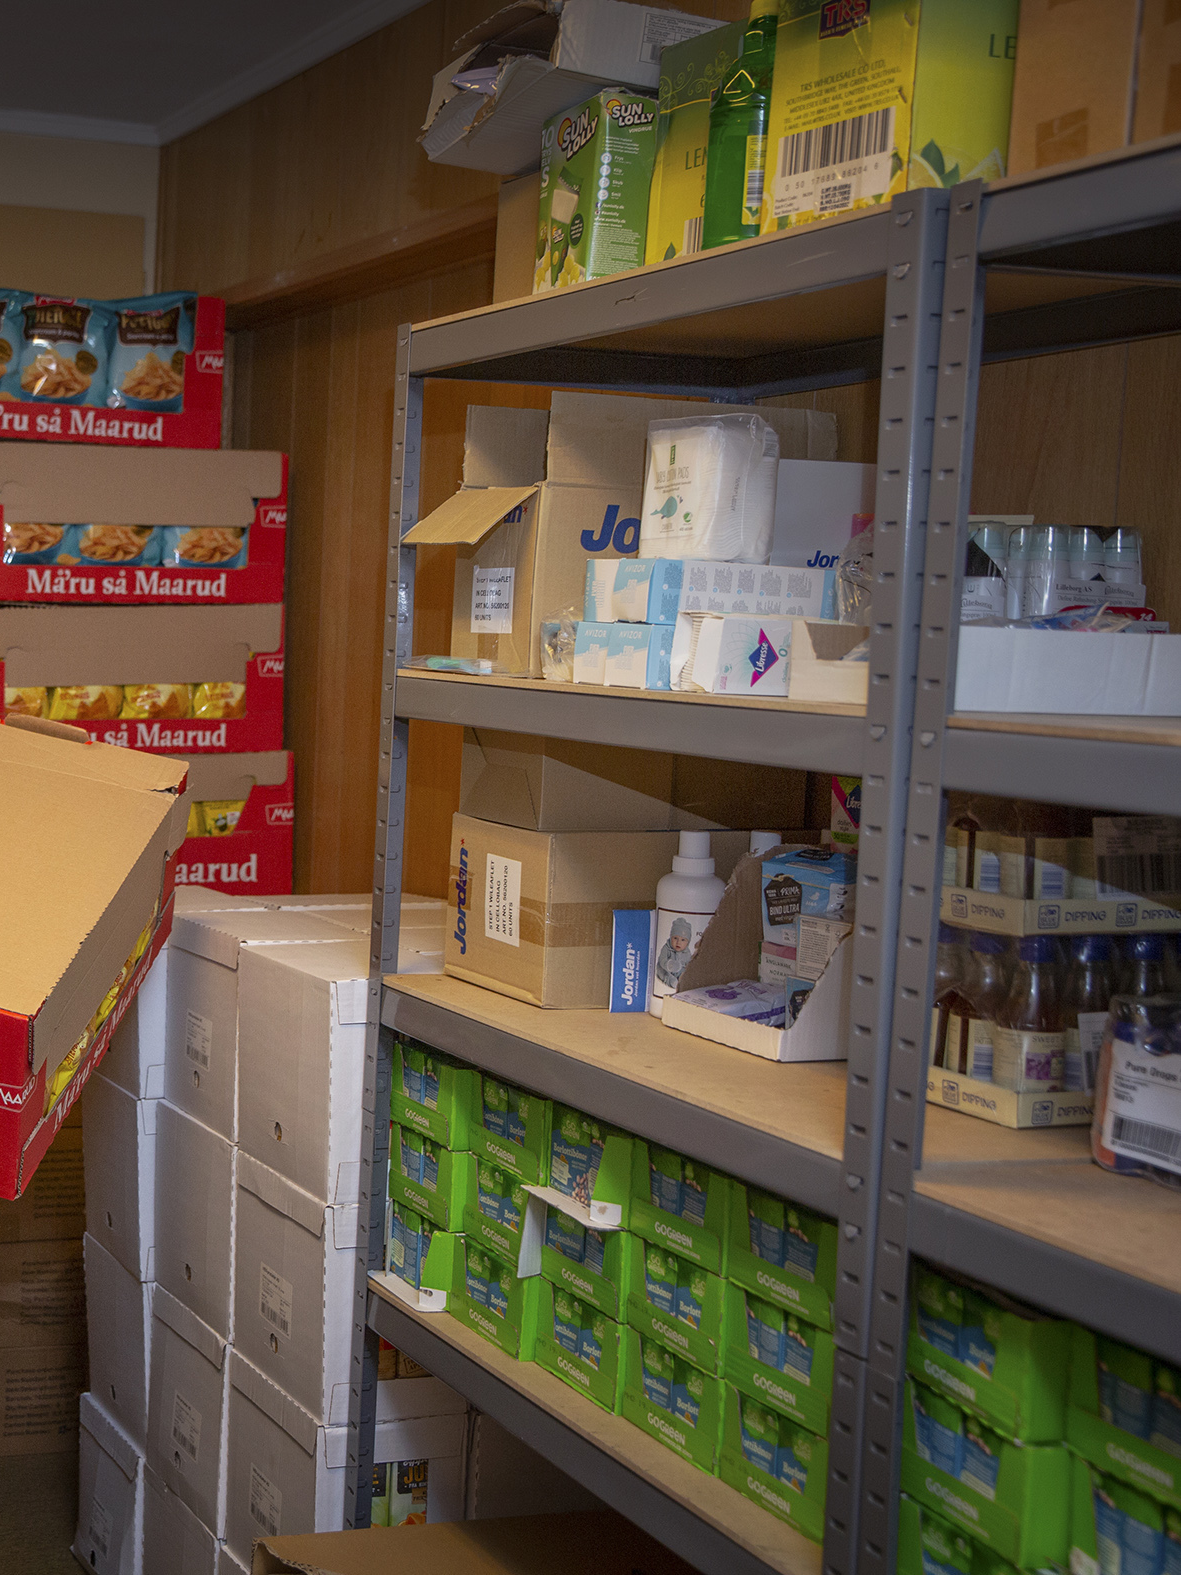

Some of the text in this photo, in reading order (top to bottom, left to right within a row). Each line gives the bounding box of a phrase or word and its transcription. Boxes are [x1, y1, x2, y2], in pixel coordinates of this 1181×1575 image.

[824, 0, 867, 27] TRS
[800, 64, 868, 92] TRS WHOLESALE CO
[612, 102, 643, 120] SUN
[619, 112, 655, 128] LOLLY
[562, 107, 590, 150] SUN
[567, 115, 598, 162] LOLLY
[36, 408, 63, 435] så
[69, 409, 164, 442] Maarud
[624, 564, 647, 573] AVIZOR
[102, 571, 127, 595] så
[134, 570, 227, 598] Maarud
[1056, 584, 1081, 593] Lilleborg
[584, 629, 607, 638] AVIZOR
[618, 629, 643, 639] AVIZOR
[754, 641, 769, 673] Libresse
[104, 724, 129, 749] så
[136, 723, 227, 749] Maarud
[454, 847, 469, 955] Jordan
[769, 905, 782, 916] BIND
[971, 903, 1005, 919] DIPPING
[1065, 910, 1107, 922] DIPPING
[622, 949, 636, 1006] Jordan
